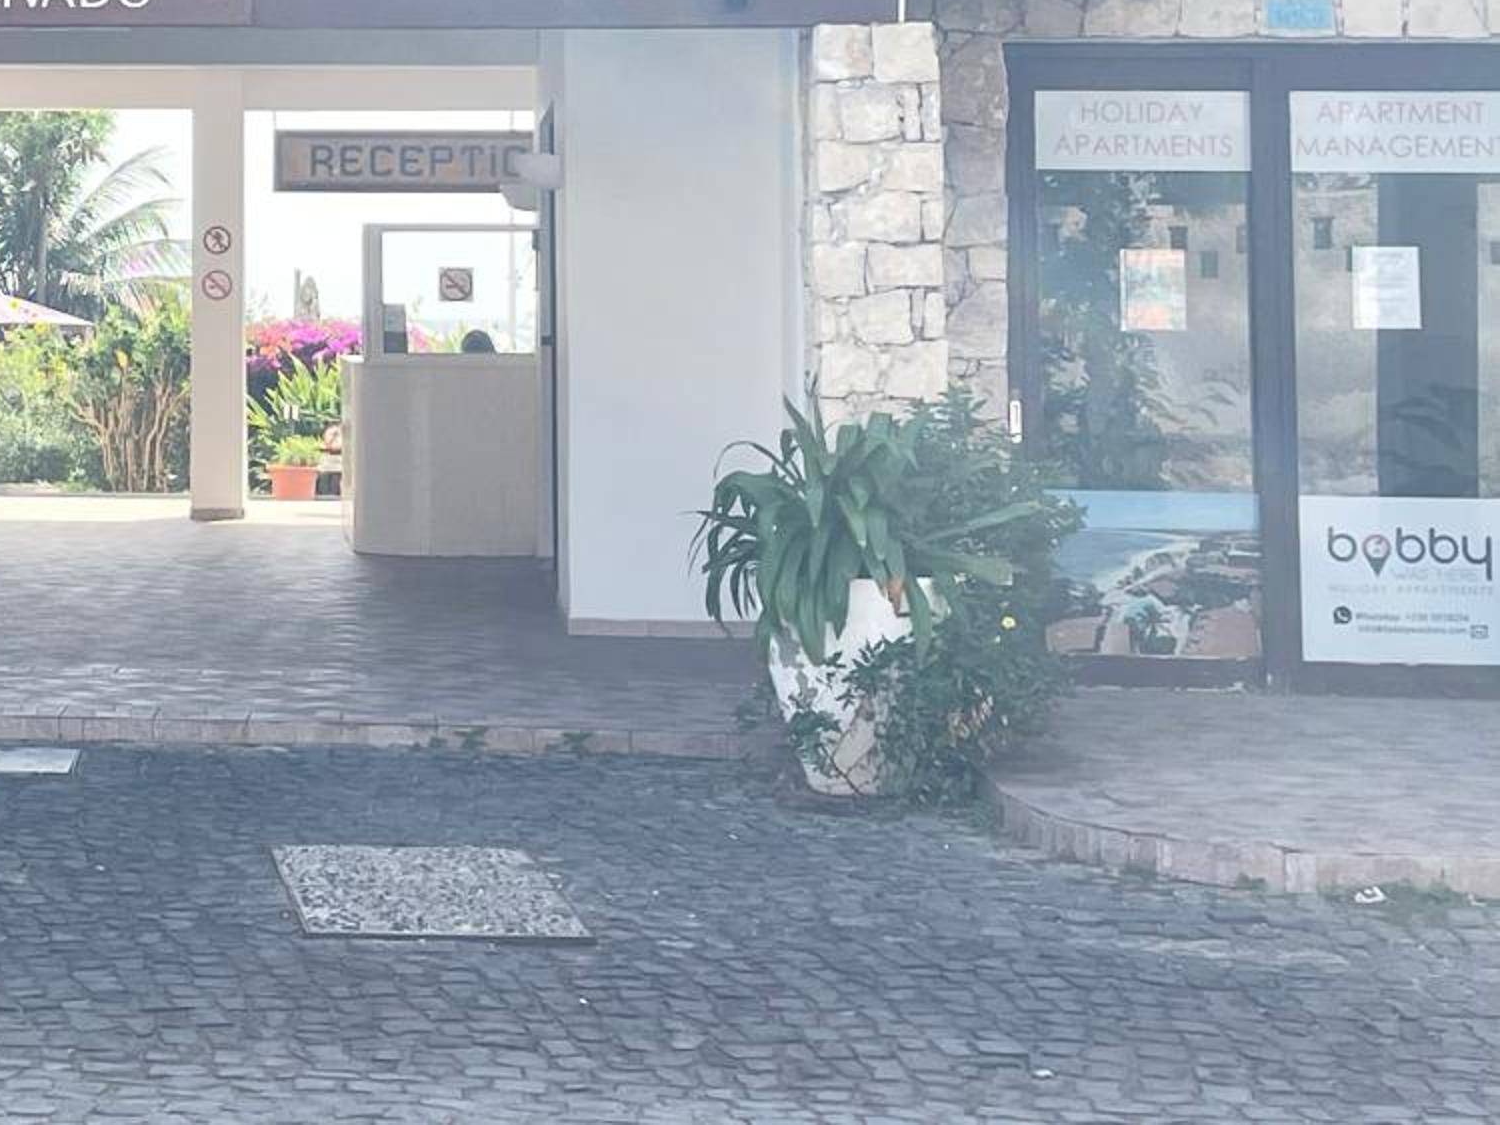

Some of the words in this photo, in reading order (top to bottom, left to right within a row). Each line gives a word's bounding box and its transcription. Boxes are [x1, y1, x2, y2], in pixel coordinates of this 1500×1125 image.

[1080, 100, 1204, 124] HOLIDAY
[1315, 101, 1485, 124] APARTMENT
[1053, 134, 1234, 157] APARTMENTS
[1327, 526, 1493, 582] bobby
